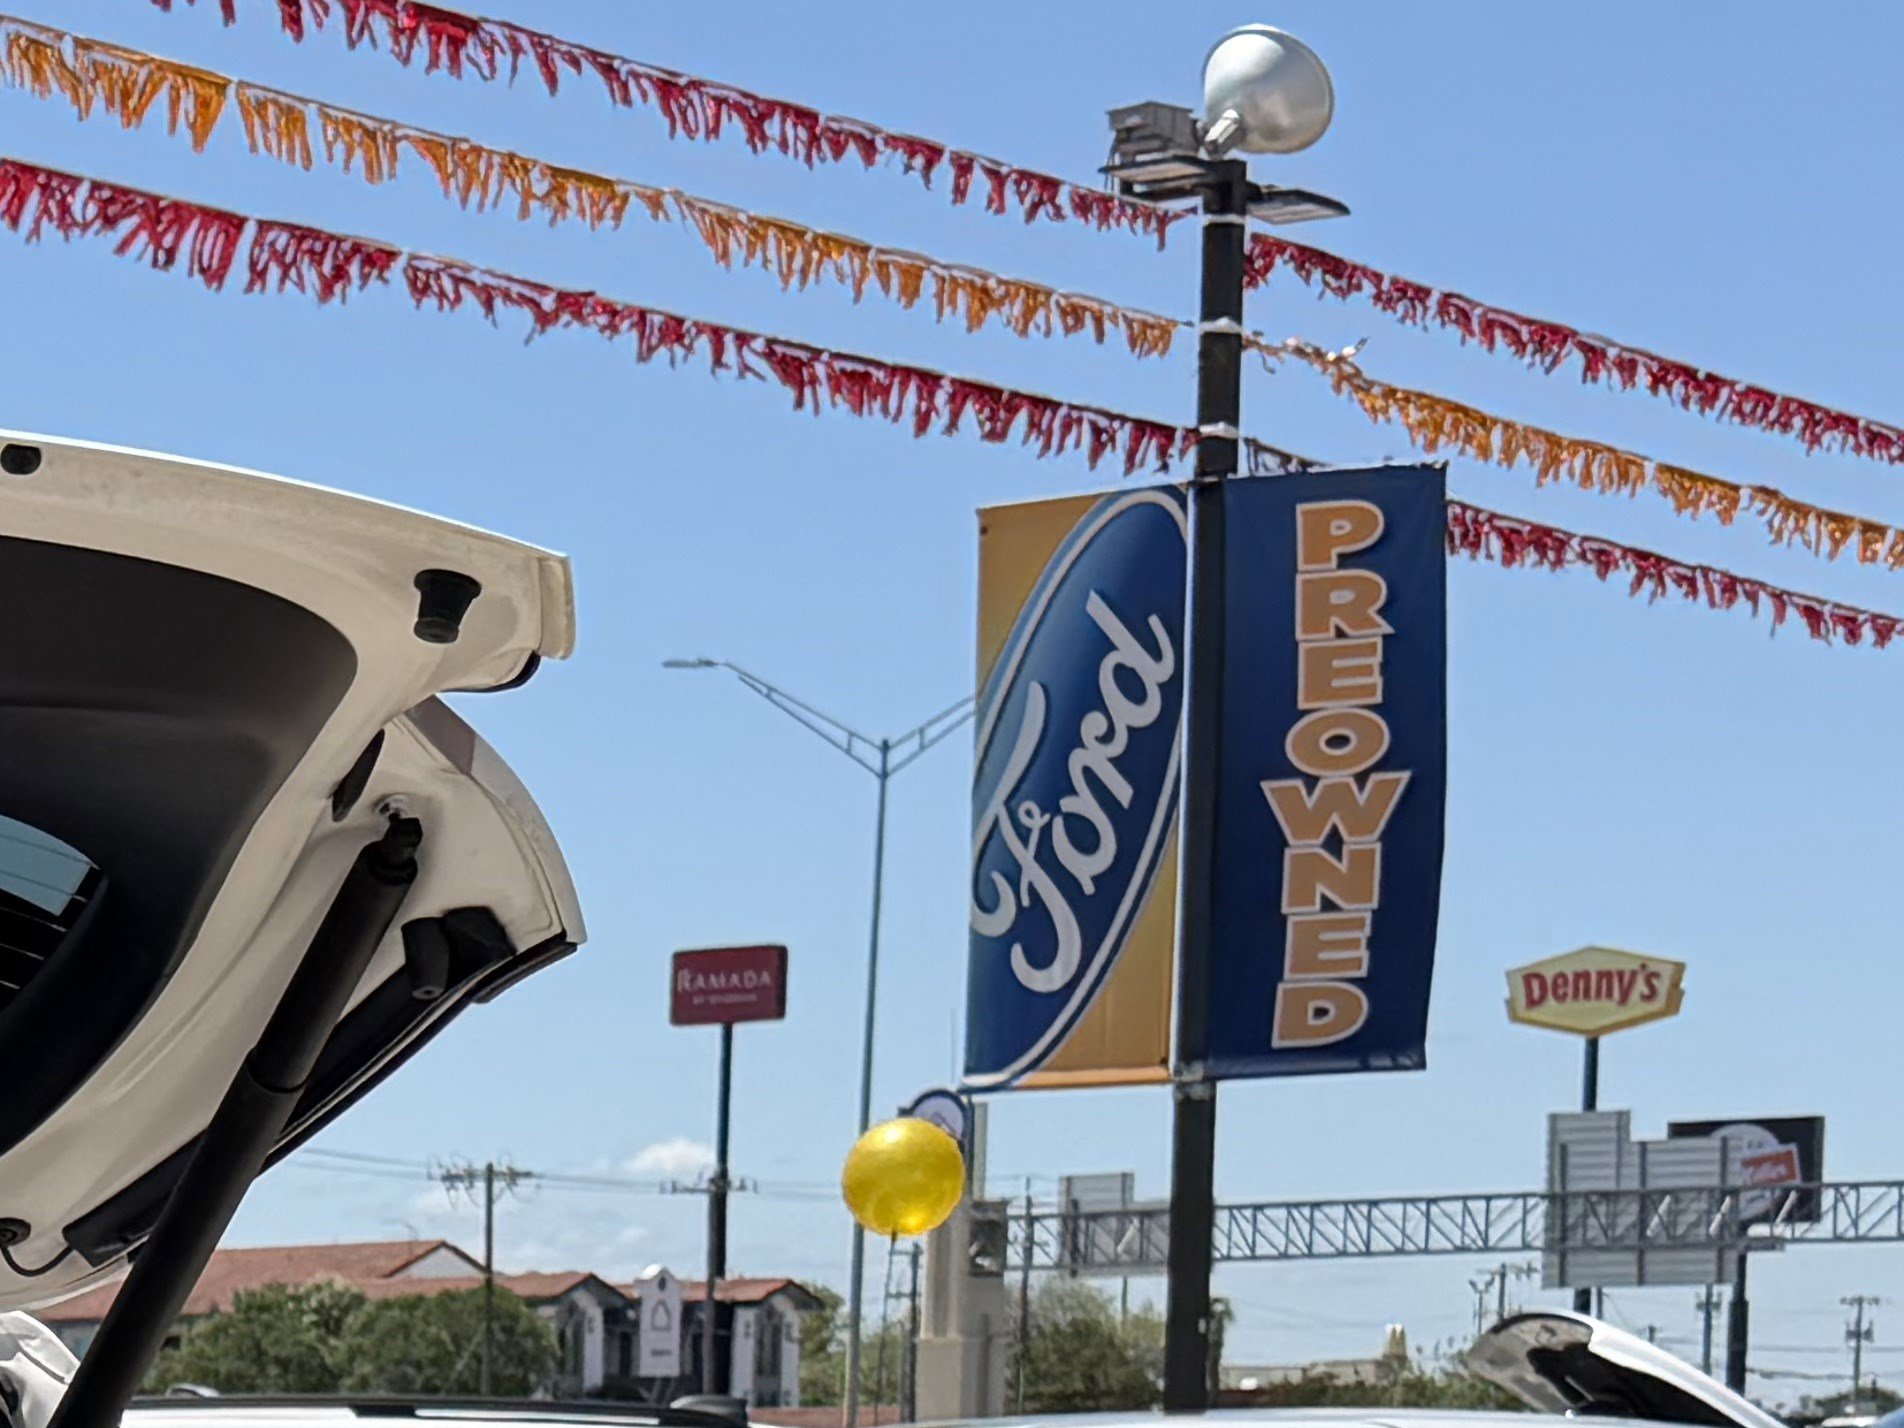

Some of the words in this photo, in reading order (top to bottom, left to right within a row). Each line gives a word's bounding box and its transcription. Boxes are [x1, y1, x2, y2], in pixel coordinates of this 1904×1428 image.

[970, 590, 1175, 993] Ford
[676, 968, 772, 993] RAMADA
[1522, 962, 1661, 1010] Denny's
